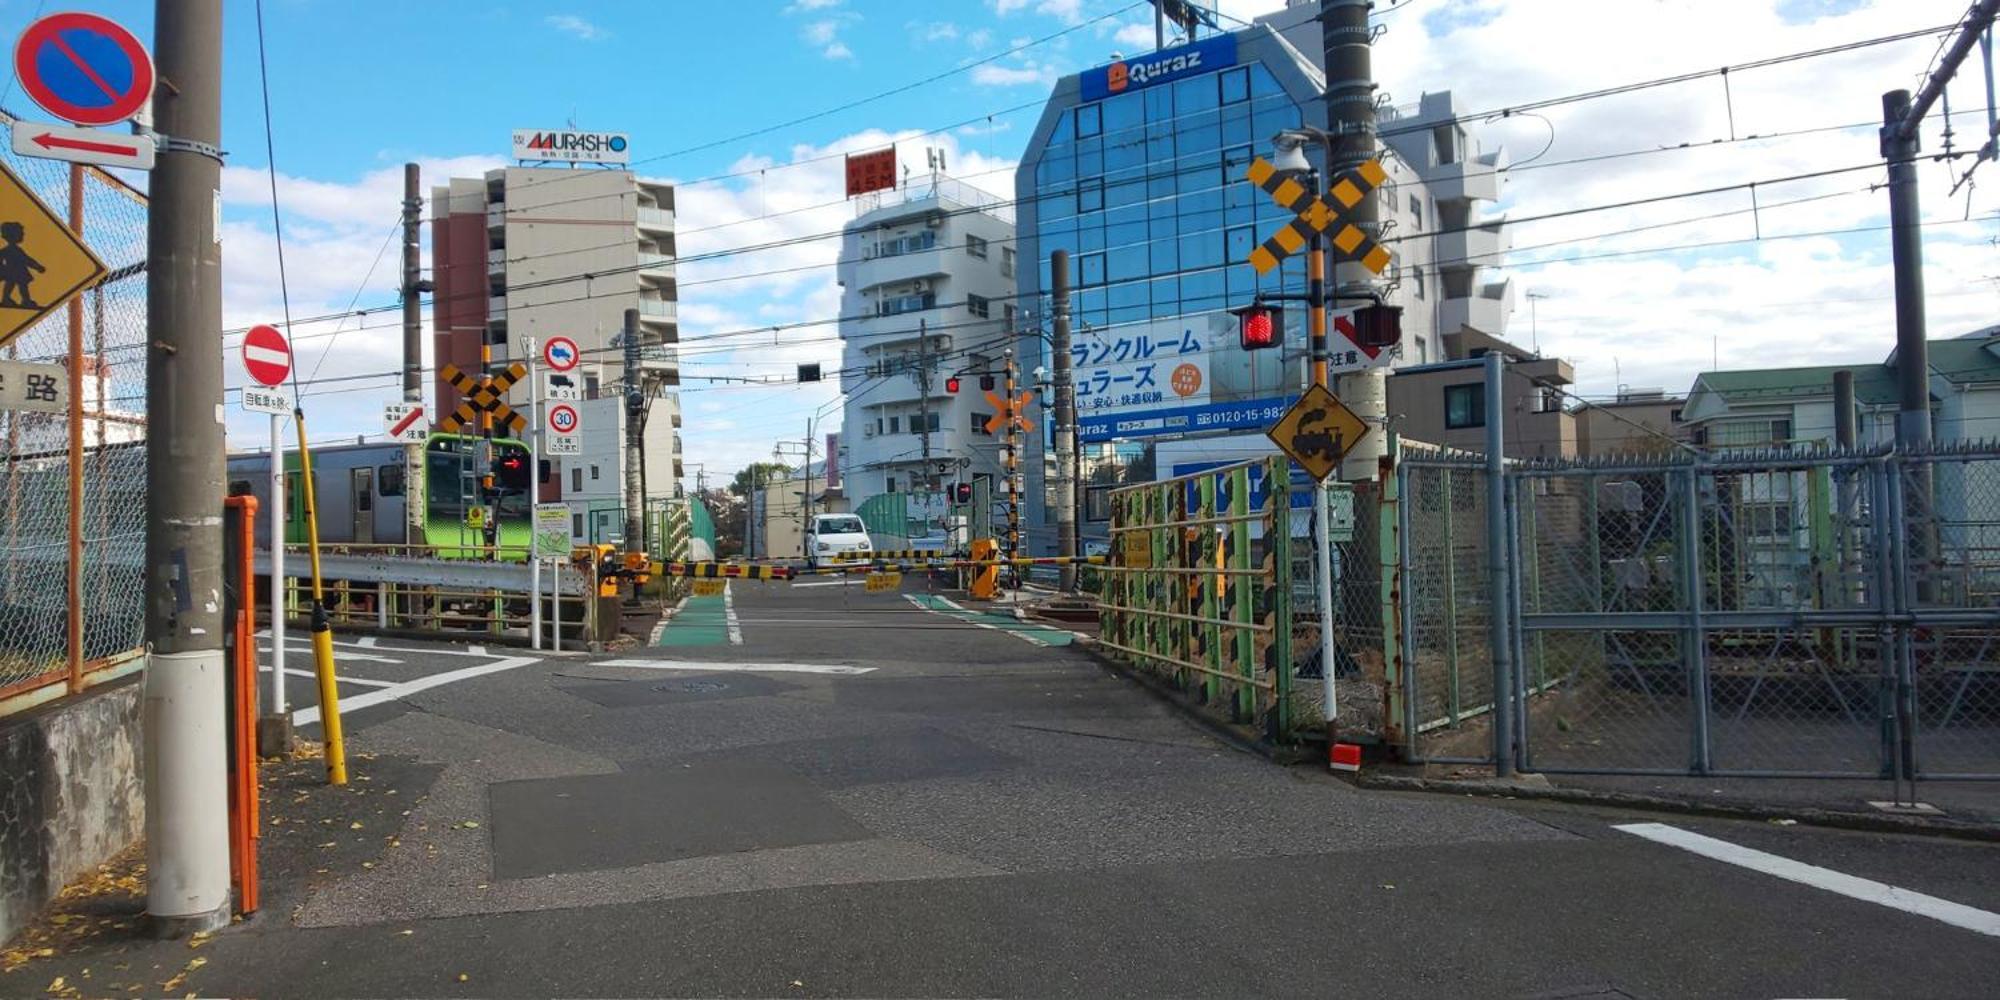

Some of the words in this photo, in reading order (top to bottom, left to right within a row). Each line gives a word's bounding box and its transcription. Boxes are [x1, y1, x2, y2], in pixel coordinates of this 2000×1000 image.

[1130, 51, 1202, 83] Quraz
[527, 131, 627, 152] MURASHO
[1072, 330, 1200, 367] ランクルーム
[1331, 351, 1358, 366] 注意
[1077, 363, 1156, 396] ュラーズ
[246, 392, 291, 410] 自転車を除く
[1077, 391, 1162, 409] い・安心・快適収納
[555, 412, 572, 425] 30
[1213, 406, 1285, 424] 0120-15-982
[406, 430, 426, 439] 注意
[1079, 423, 1108, 436] uraz
